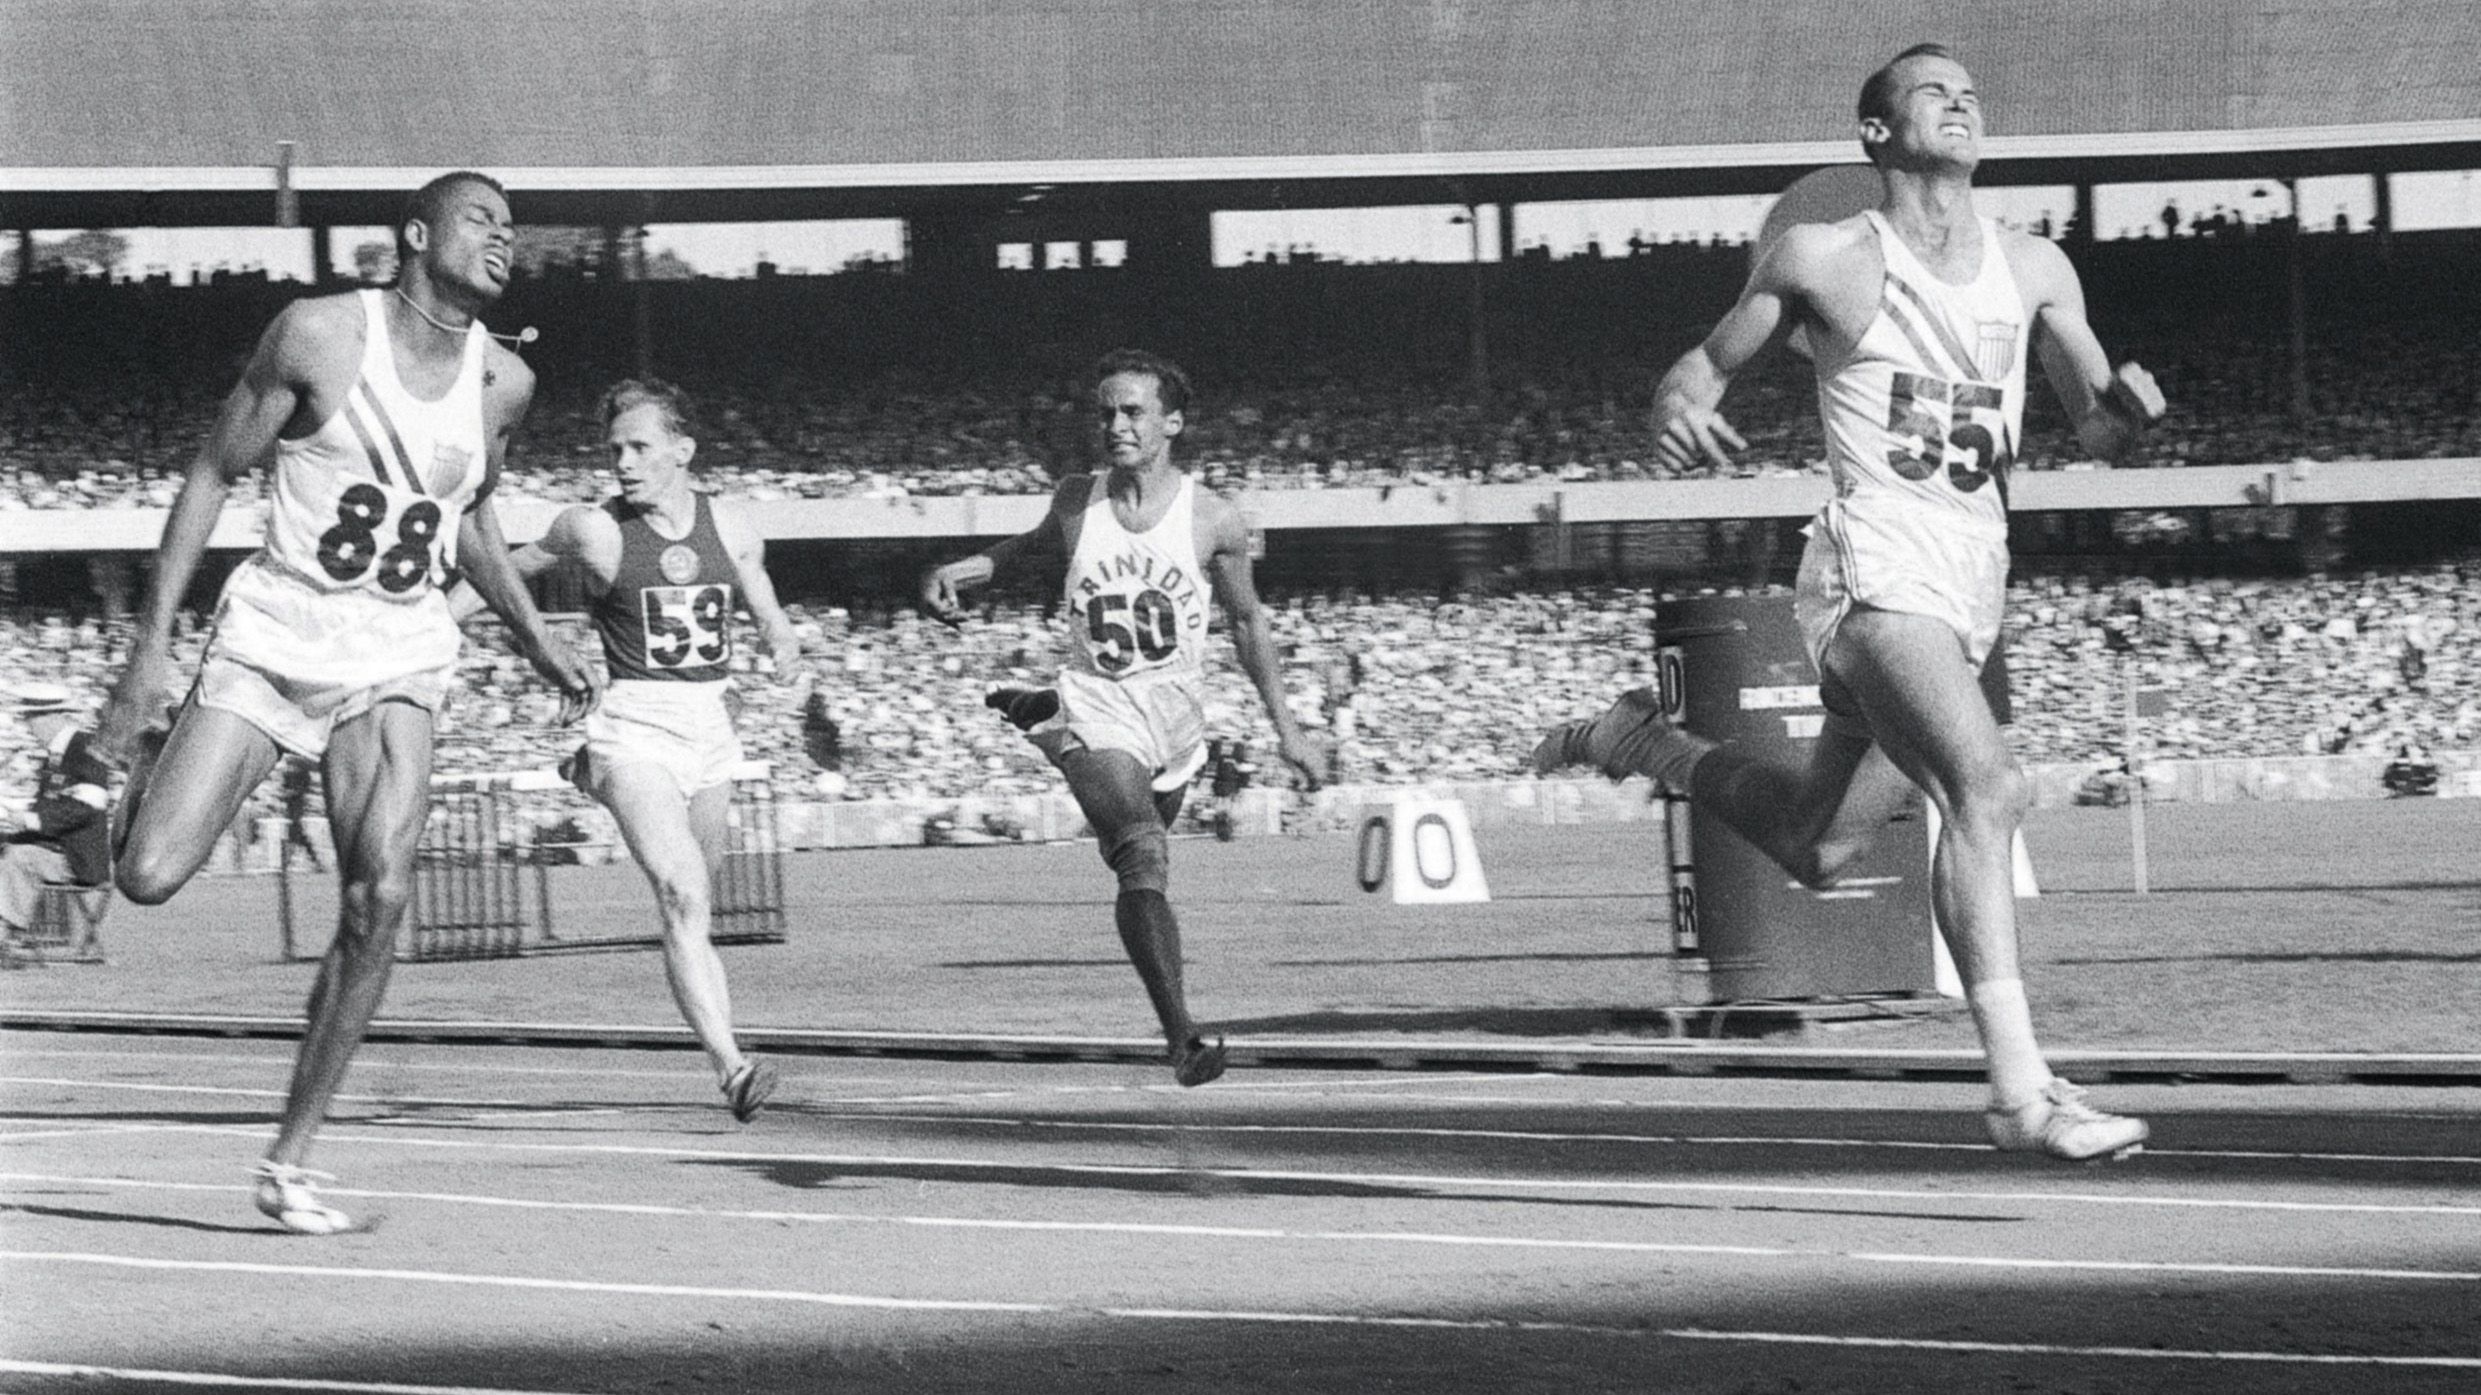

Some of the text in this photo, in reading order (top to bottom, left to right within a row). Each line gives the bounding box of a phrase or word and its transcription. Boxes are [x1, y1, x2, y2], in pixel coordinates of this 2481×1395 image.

[1887, 372, 2003, 493] 55
[317, 483, 441, 593] 88
[646, 587, 725, 666] 59
[1070, 554, 1201, 630] TRINIDAD
[1087, 590, 1178, 672] 50
